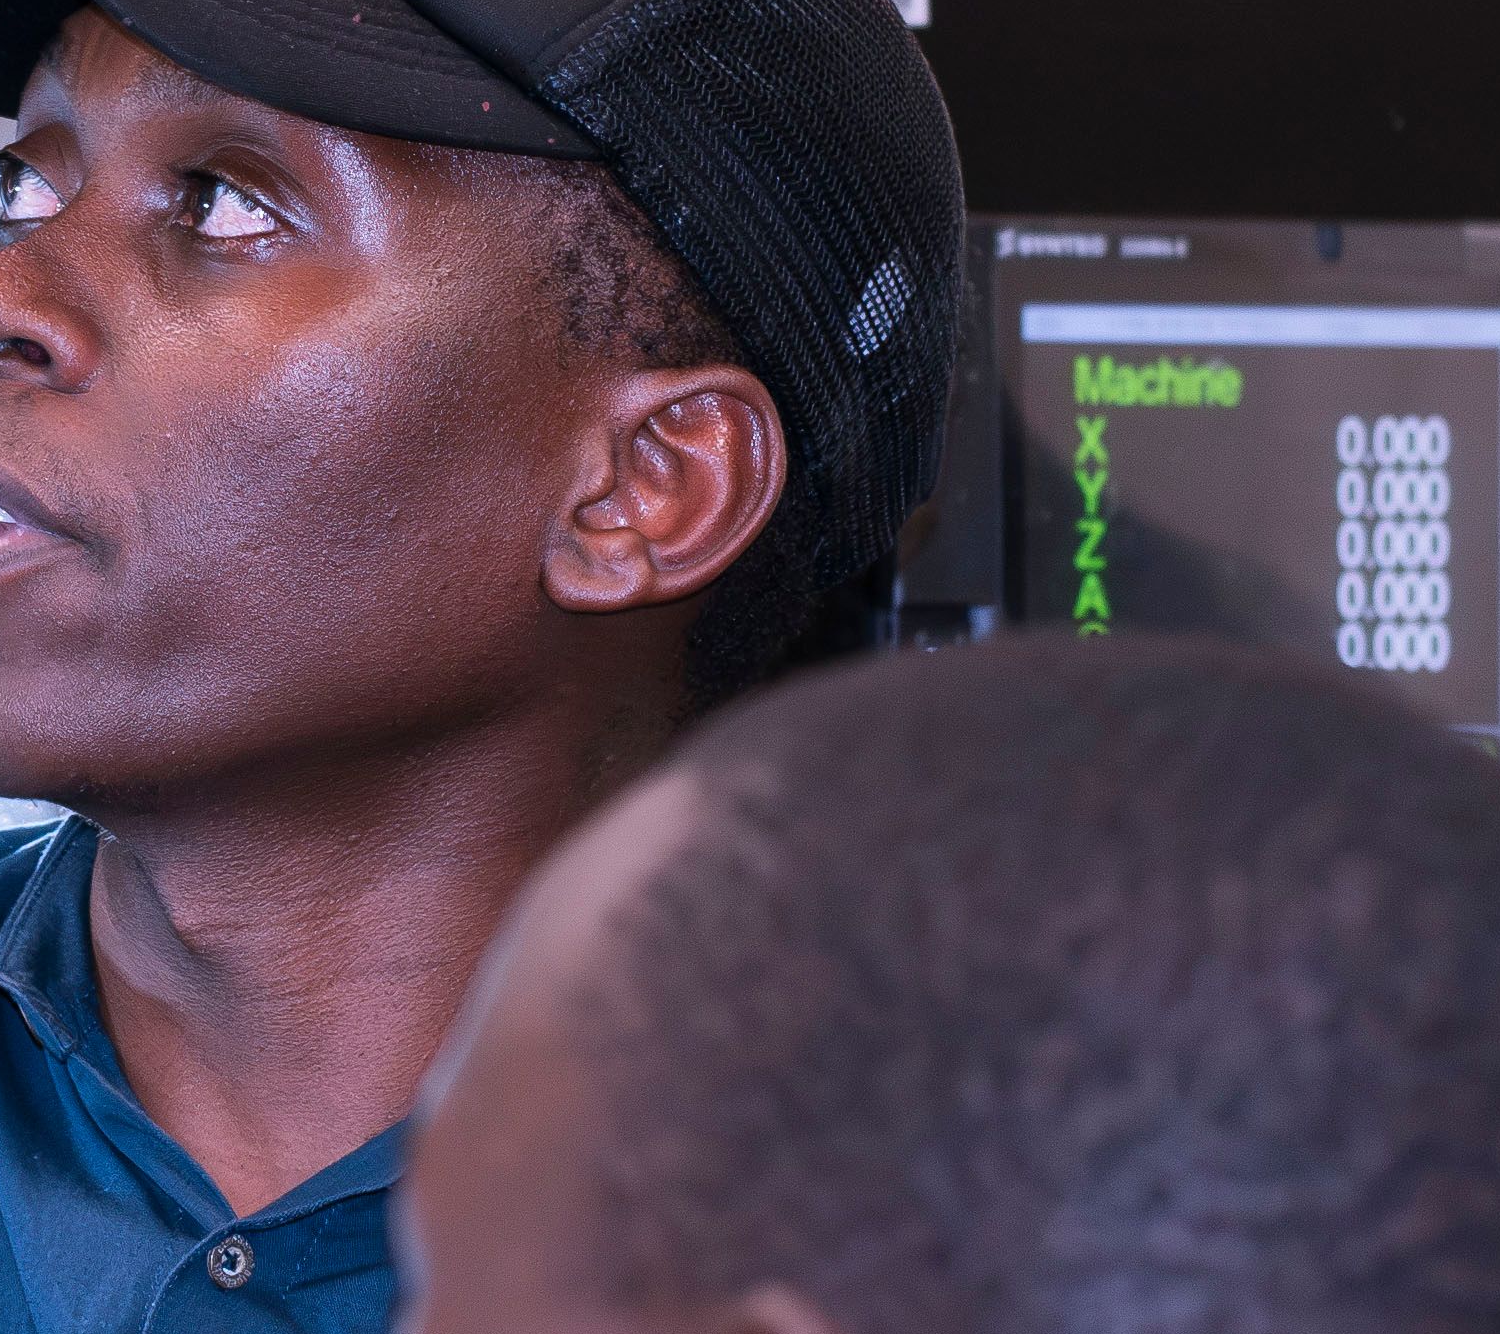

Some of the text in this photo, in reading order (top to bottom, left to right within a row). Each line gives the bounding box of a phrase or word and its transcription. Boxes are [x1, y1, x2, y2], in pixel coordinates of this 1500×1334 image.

[1074, 355, 1243, 408] Machine
[1075, 415, 1451, 467] X 0.000
[1074, 467, 1451, 518] Y 0.000
[1074, 517, 1451, 570] Z 0.000
[1073, 568, 1451, 620] A 0.000
